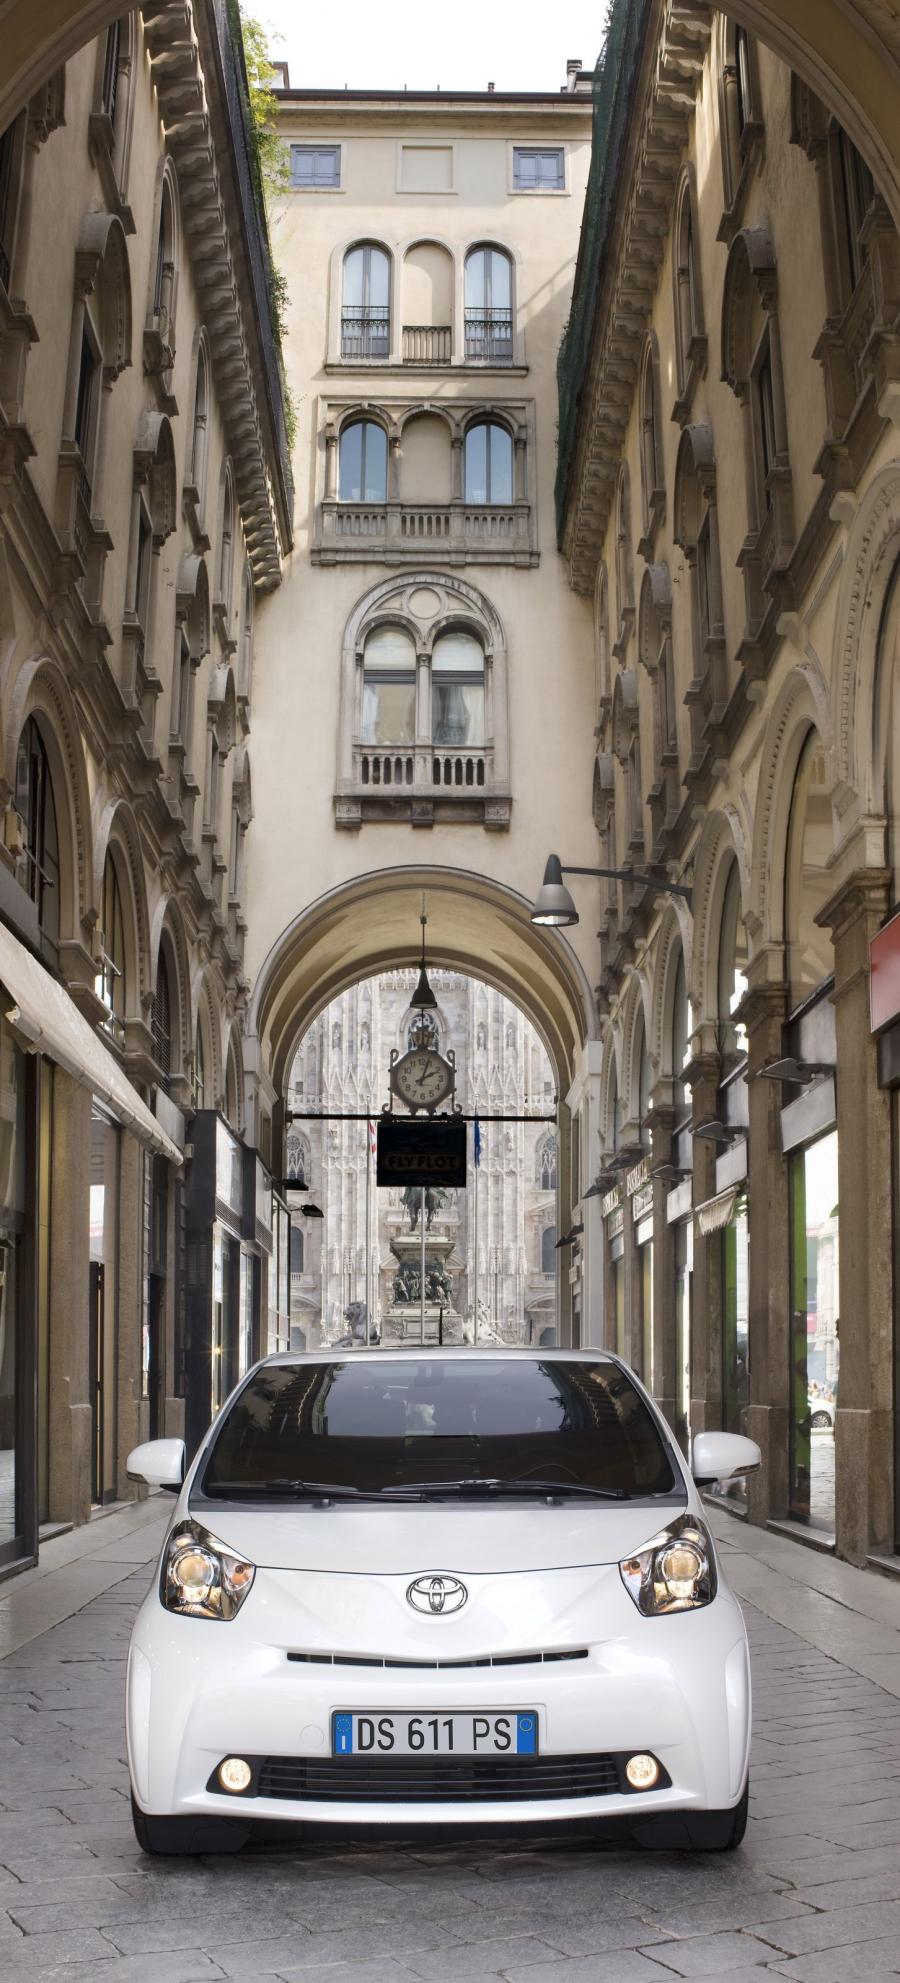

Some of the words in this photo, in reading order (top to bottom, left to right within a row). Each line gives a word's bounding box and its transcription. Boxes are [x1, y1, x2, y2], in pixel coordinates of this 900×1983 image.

[434, 1083, 440, 1091] 4
[388, 1156, 414, 1168] FLY
[357, 1718, 395, 1750] DS
[408, 1718, 454, 1750] 611
[473, 1718, 511, 1750] PS
